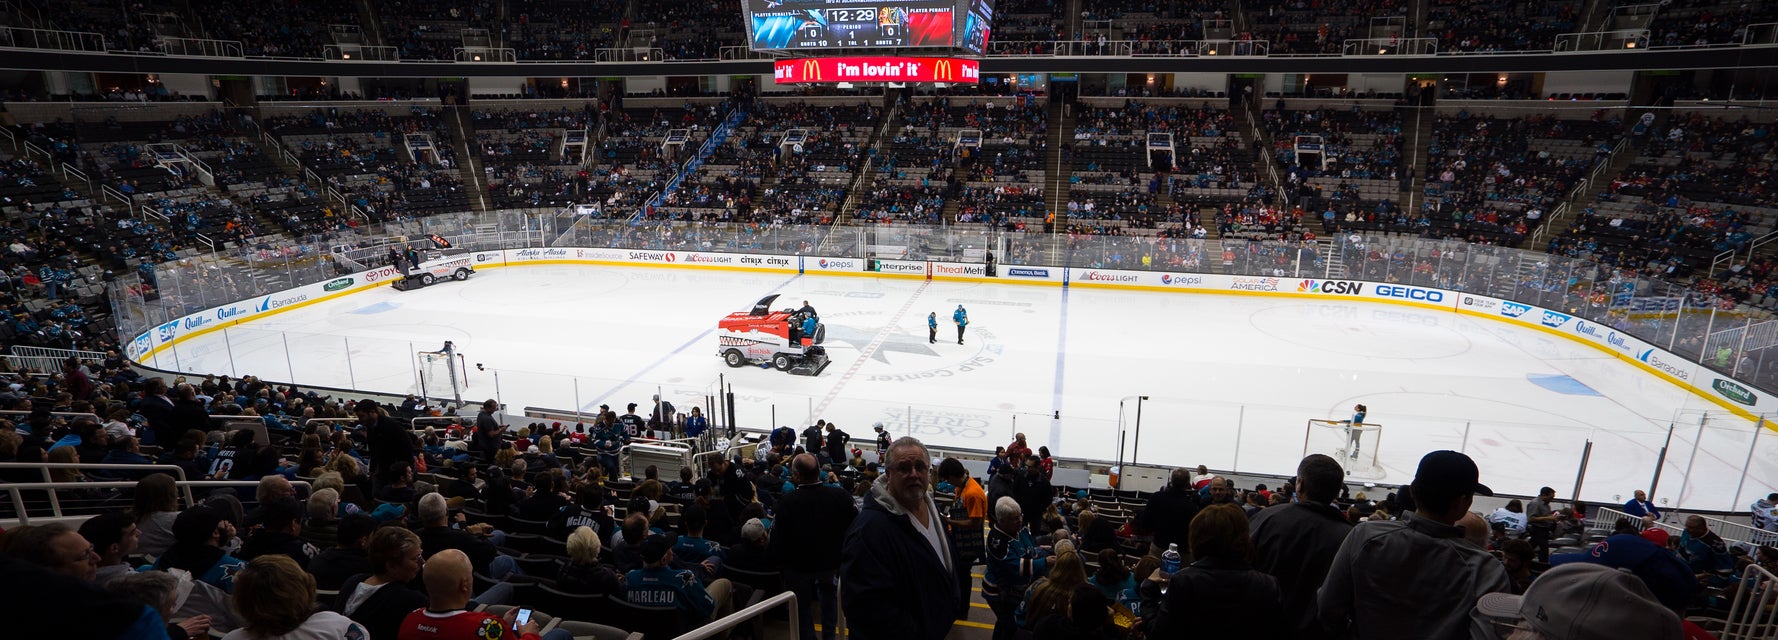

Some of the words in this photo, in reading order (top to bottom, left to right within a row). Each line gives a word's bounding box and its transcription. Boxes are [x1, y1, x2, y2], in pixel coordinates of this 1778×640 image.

[832, 10, 874, 21] 12:29
[888, 28, 894, 36] 0
[838, 63, 860, 76] i'm
[863, 62, 904, 76] lovin'
[907, 62, 918, 76] it
[629, 252, 664, 261] SAFEWAY
[692, 254, 713, 262] Coors
[830, 261, 853, 269] pepsi
[1089, 271, 1114, 281] Coors
[1174, 275, 1202, 285] pepsi
[1231, 283, 1278, 291] AMERICA
[1322, 280, 1363, 295] CSN
[1376, 285, 1443, 302] GEICO
[272, 294, 307, 308] Barracuda
[218, 307, 246, 320] Quill.com
[1502, 304, 1524, 316] SAP
[185, 316, 212, 330] Quill.com
[1542, 313, 1565, 326] SAP
[160, 326, 176, 340] SAP
[1576, 321, 1602, 339] Quill.com
[138, 336, 150, 350] SAP
[1608, 332, 1630, 350] Quill.com
[958, 356, 994, 373] SAP
[1652, 356, 1688, 380] Barracuda
[866, 369, 954, 383] Center
[1720, 380, 1750, 400] Orchard
[566, 516, 600, 533] McLAREN
[628, 590, 674, 602] MARLEAU
